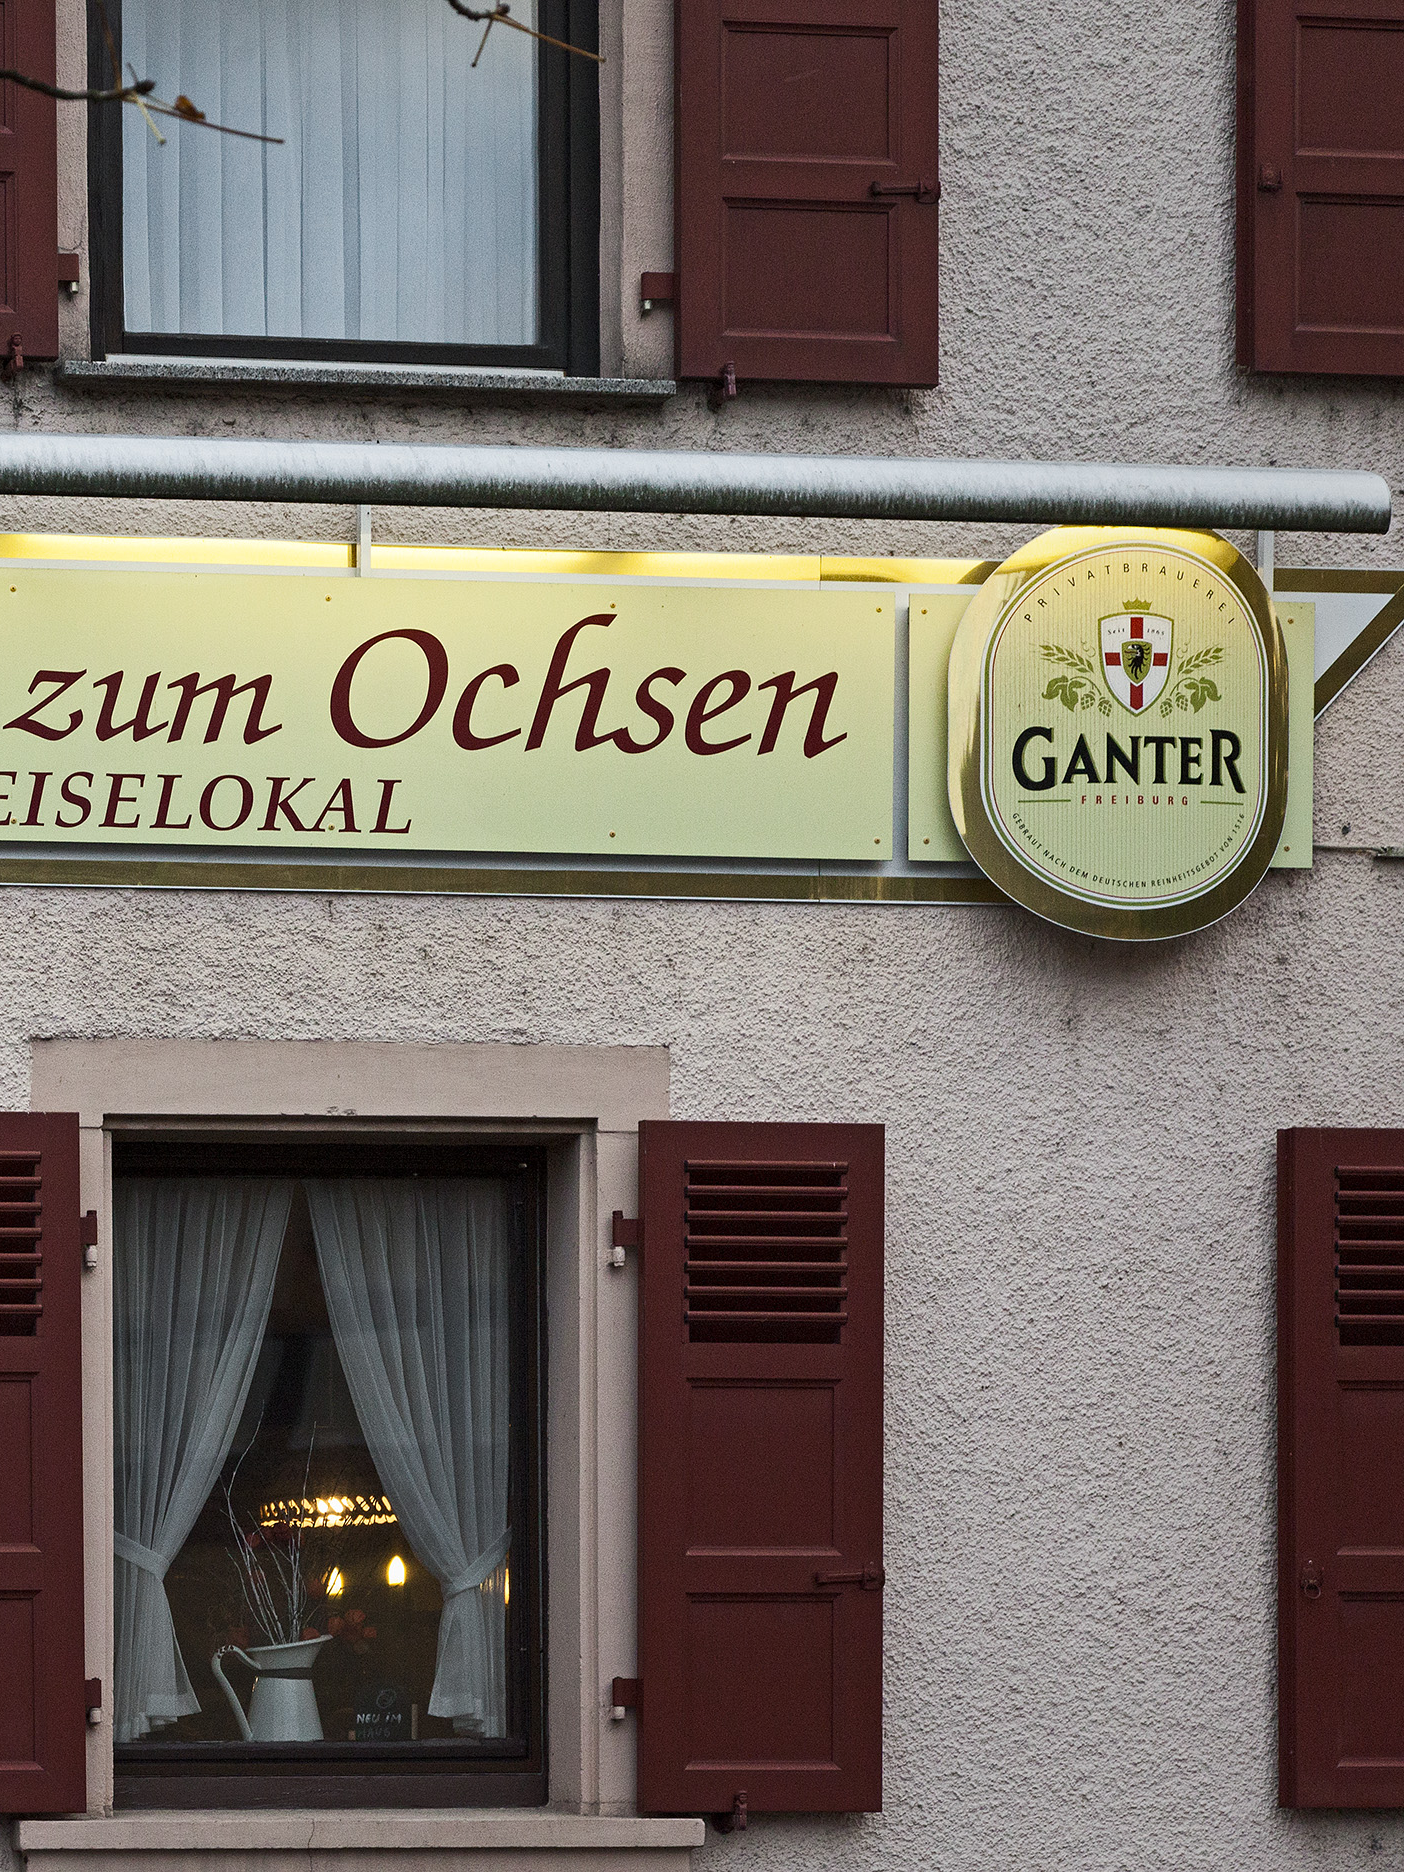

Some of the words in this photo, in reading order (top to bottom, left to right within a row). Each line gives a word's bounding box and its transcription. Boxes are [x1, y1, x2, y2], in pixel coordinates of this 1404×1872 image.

[1023, 562, 1235, 625] PRIVATBRAUEREI
[2, 668, 282, 745] zum
[329, 613, 848, 759] Ochsen
[1011, 725, 1247, 794] GANTER
[1081, 794, 1188, 806] FREIBURG
[1012, 812, 1043, 850] GEBRAUT
[1042, 849, 1067, 869] NACH
[1069, 865, 1089, 879] DEM
[1092, 874, 1147, 888] DEUTSCHEN
[1150, 851, 1219, 888] REINHEITSGEBOT
[1218, 835, 1233, 852] VON
[1231, 812, 1245, 834] 1516
[356, 1713, 380, 1724] NEU
